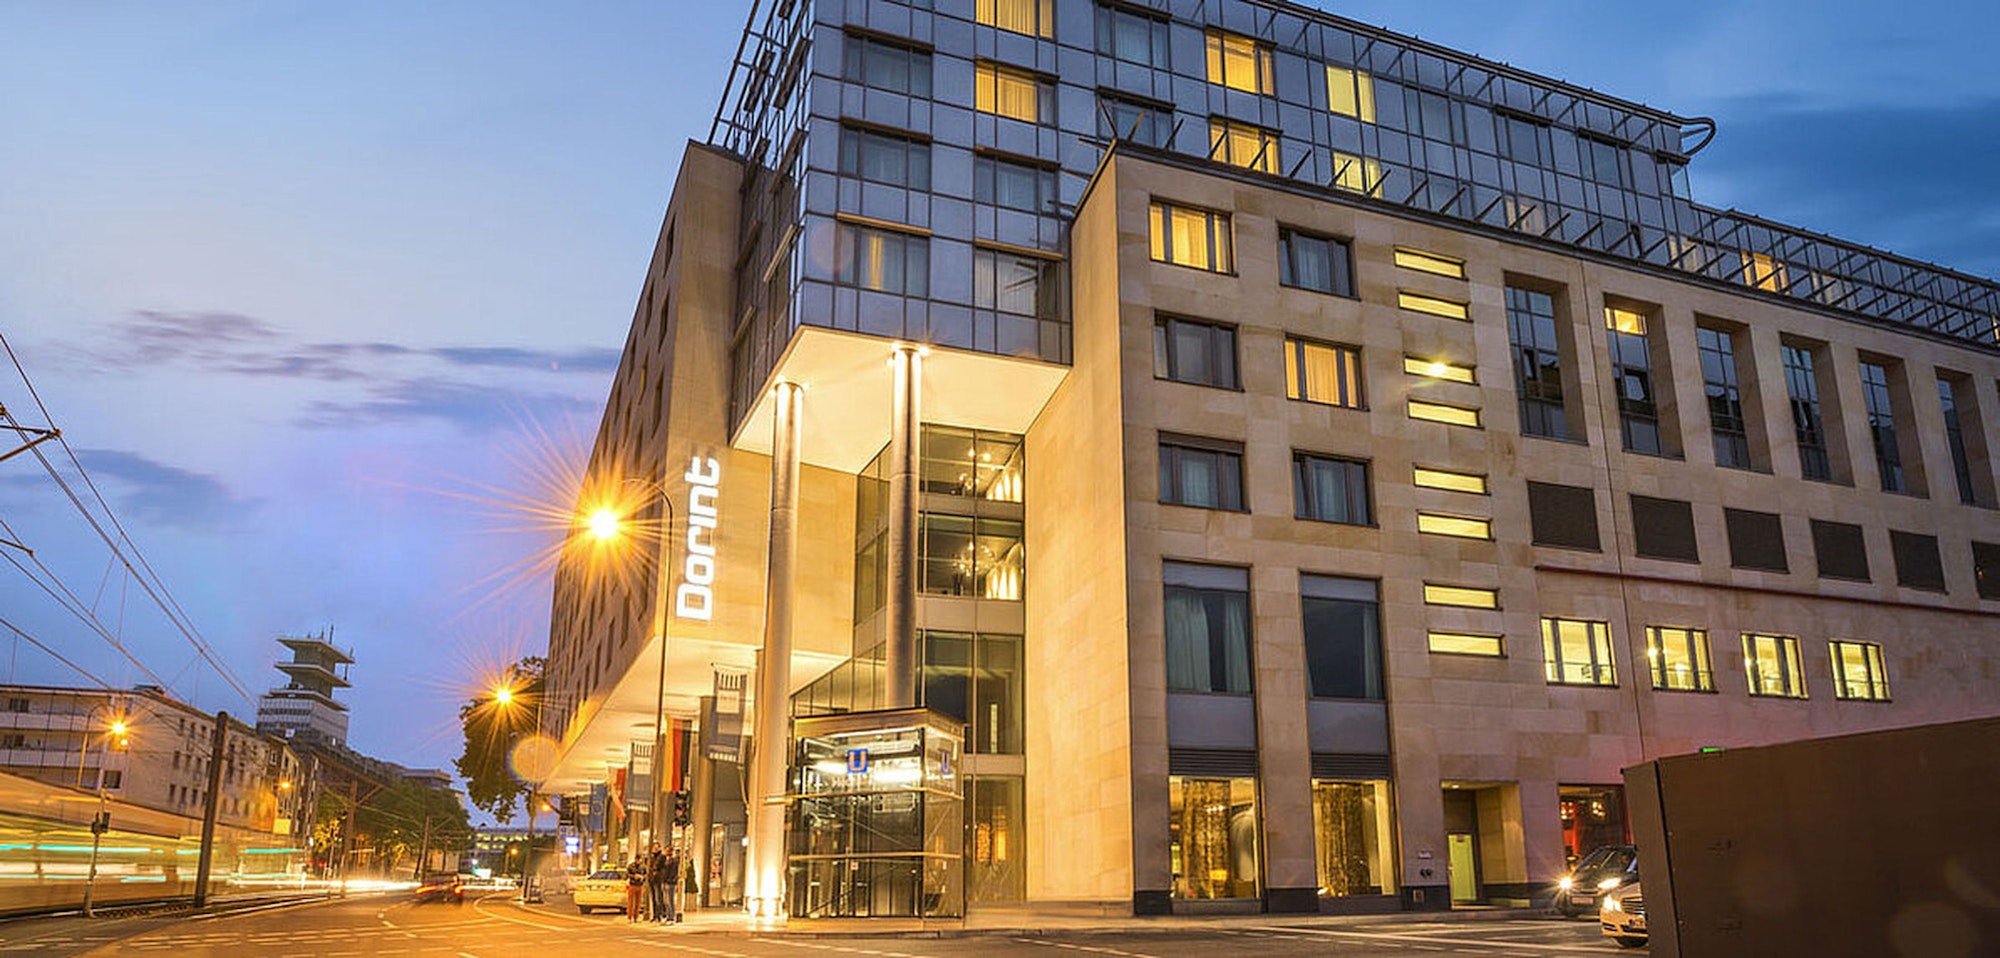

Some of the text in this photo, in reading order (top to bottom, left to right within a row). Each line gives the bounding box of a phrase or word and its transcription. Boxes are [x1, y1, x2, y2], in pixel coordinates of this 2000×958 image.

[676, 456, 721, 621] Dorint
[848, 751, 867, 771] U
[941, 751, 950, 774] U
